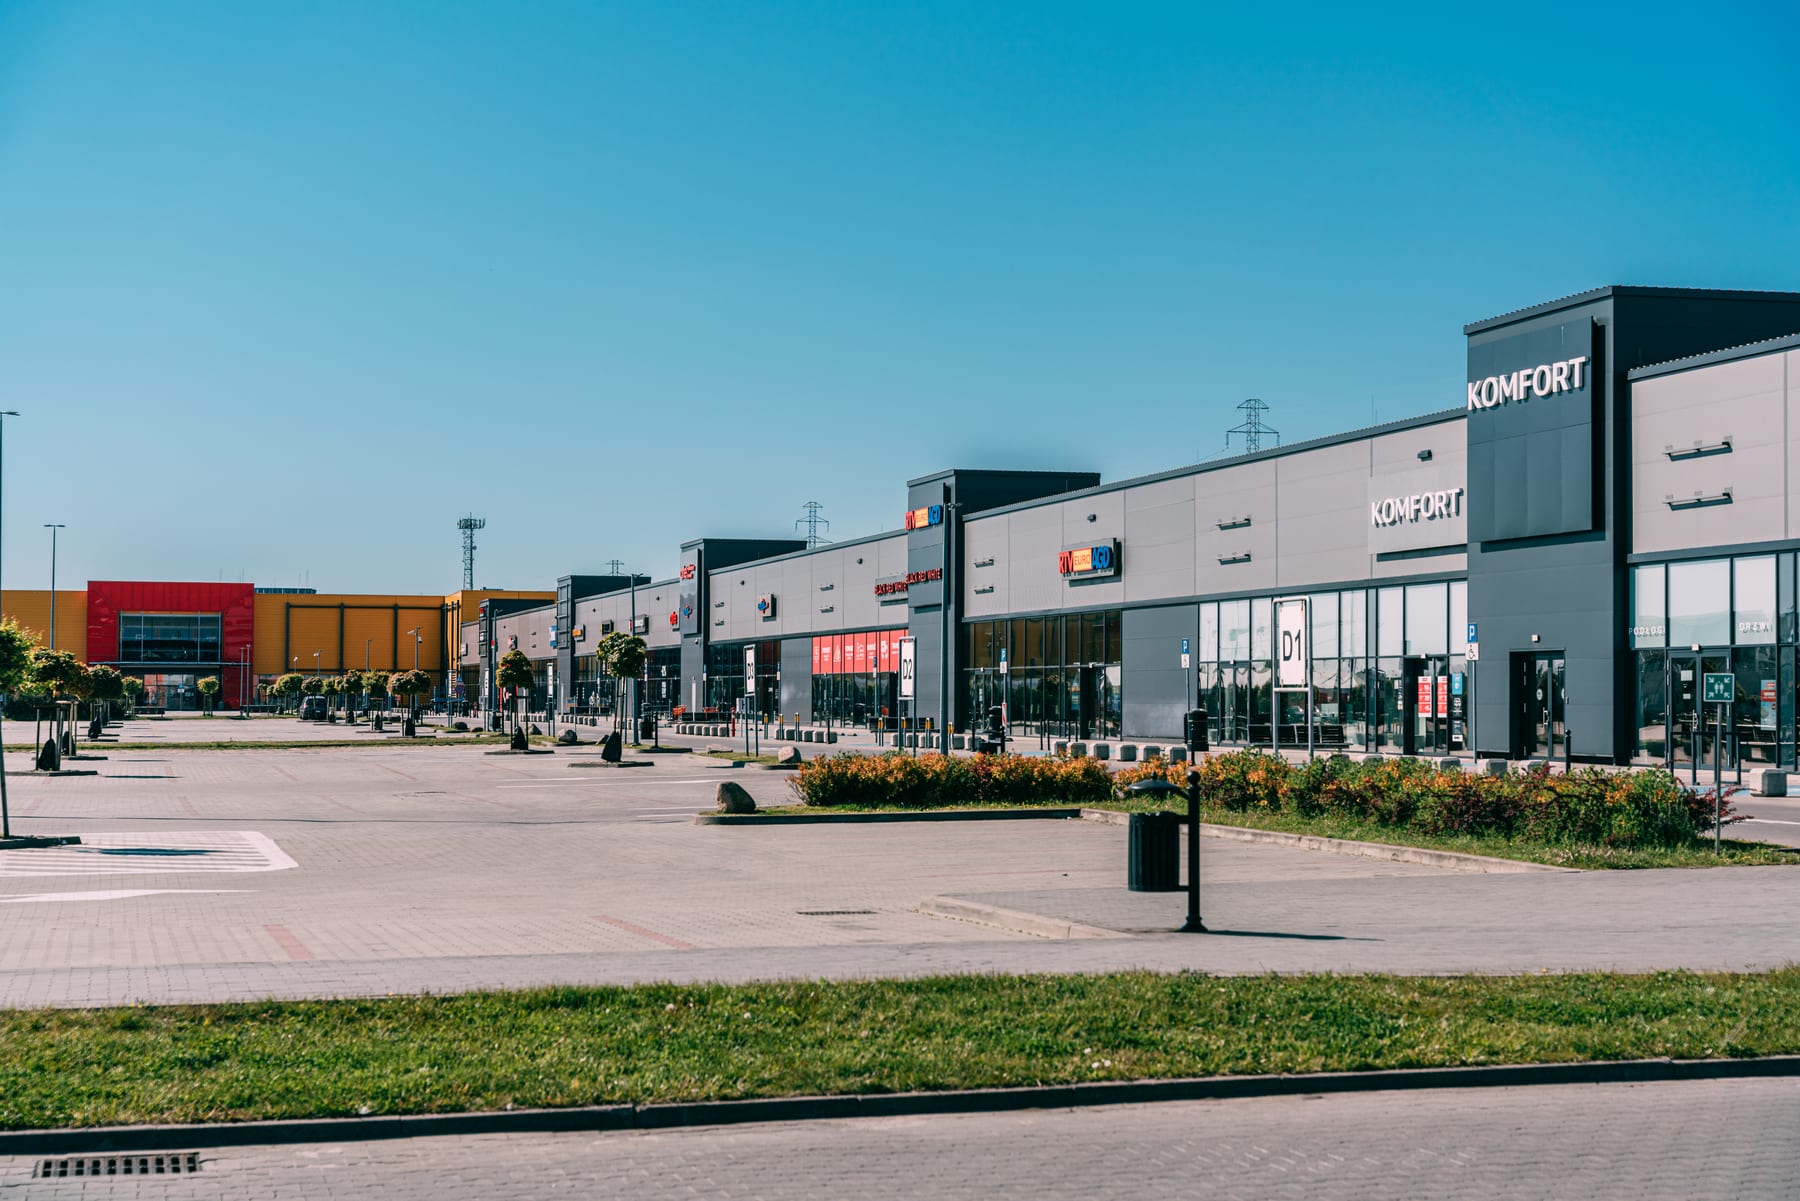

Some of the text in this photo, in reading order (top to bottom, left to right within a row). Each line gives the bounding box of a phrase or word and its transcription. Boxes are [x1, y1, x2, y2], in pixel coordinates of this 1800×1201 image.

[1467, 356, 1586, 411] KOMFORT
[1371, 488, 1461, 525] KOMFORT
[1058, 545, 1111, 574] RTV EURO AGD
[1282, 630, 1302, 662] D1
[1469, 625, 1476, 641] P
[903, 659, 913, 680] D2
